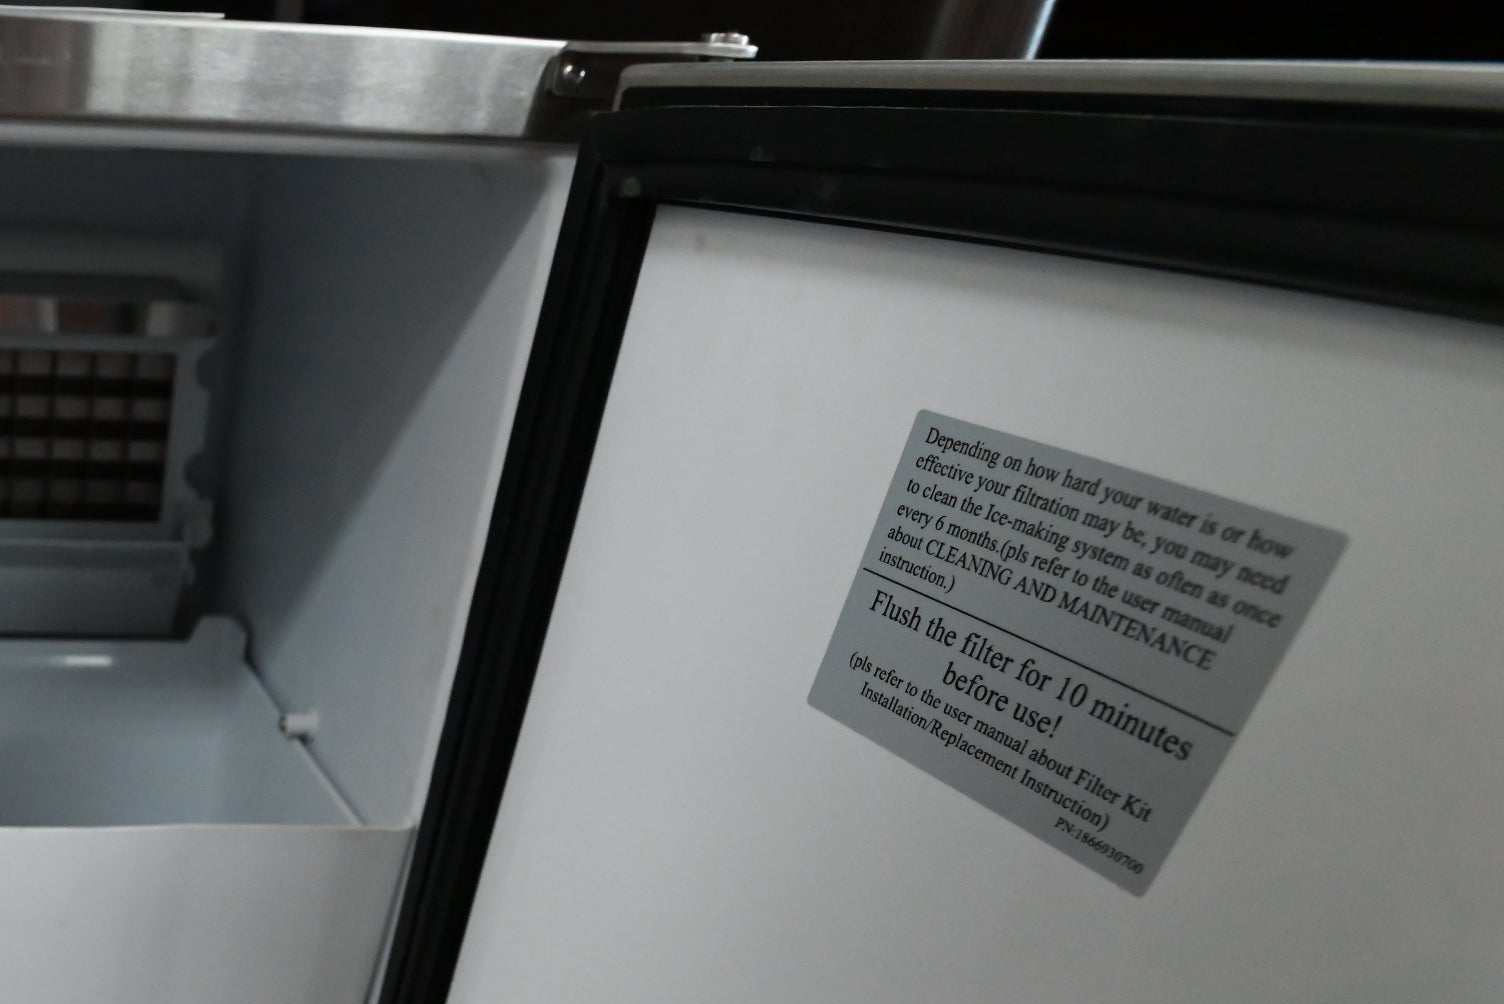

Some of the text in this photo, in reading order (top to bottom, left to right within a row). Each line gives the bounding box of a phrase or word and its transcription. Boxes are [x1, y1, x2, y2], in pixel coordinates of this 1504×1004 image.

[906, 478, 1283, 629] to clean the Ice-making system as often as once
[916, 454, 1291, 595] effective your filtration may be, you may need
[925, 427, 1296, 559] Depending on how hard your water is or how
[878, 546, 956, 594] instruction.)
[887, 526, 1217, 671] about CLEANING AND MAINTENANCE
[897, 503, 1236, 644] every 6 months.(pls refer to the user manual
[849, 651, 1153, 822] (pls refer to the user manual about Filter Kit
[869, 589, 1194, 761] Flush the filter for 10 minutes
[942, 661, 1063, 738] before use!
[860, 682, 1110, 833] Installation/Replacement Instruction)
